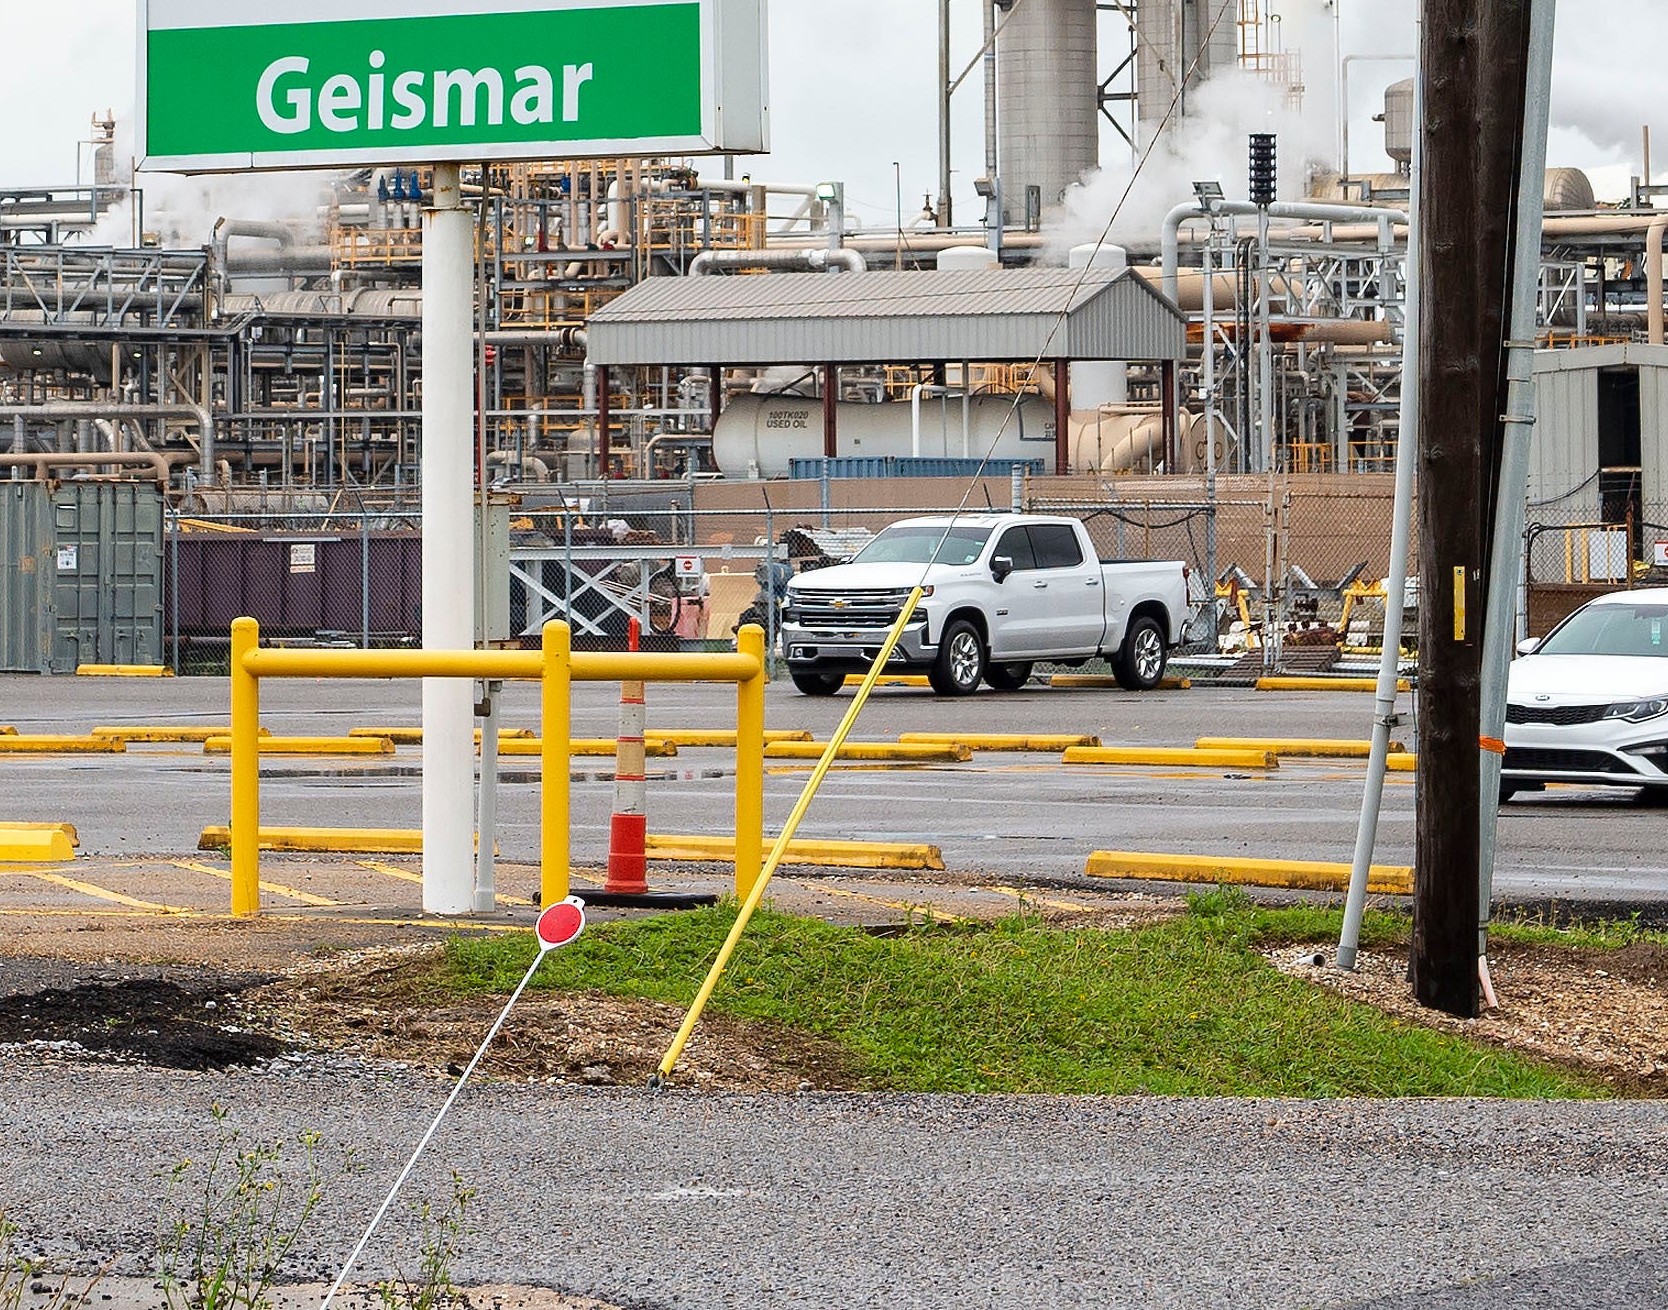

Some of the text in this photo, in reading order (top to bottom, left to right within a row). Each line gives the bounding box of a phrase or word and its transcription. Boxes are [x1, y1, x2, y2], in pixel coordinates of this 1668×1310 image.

[256, 49, 593, 134] Geismar
[766, 420, 808, 428] USED OIL
